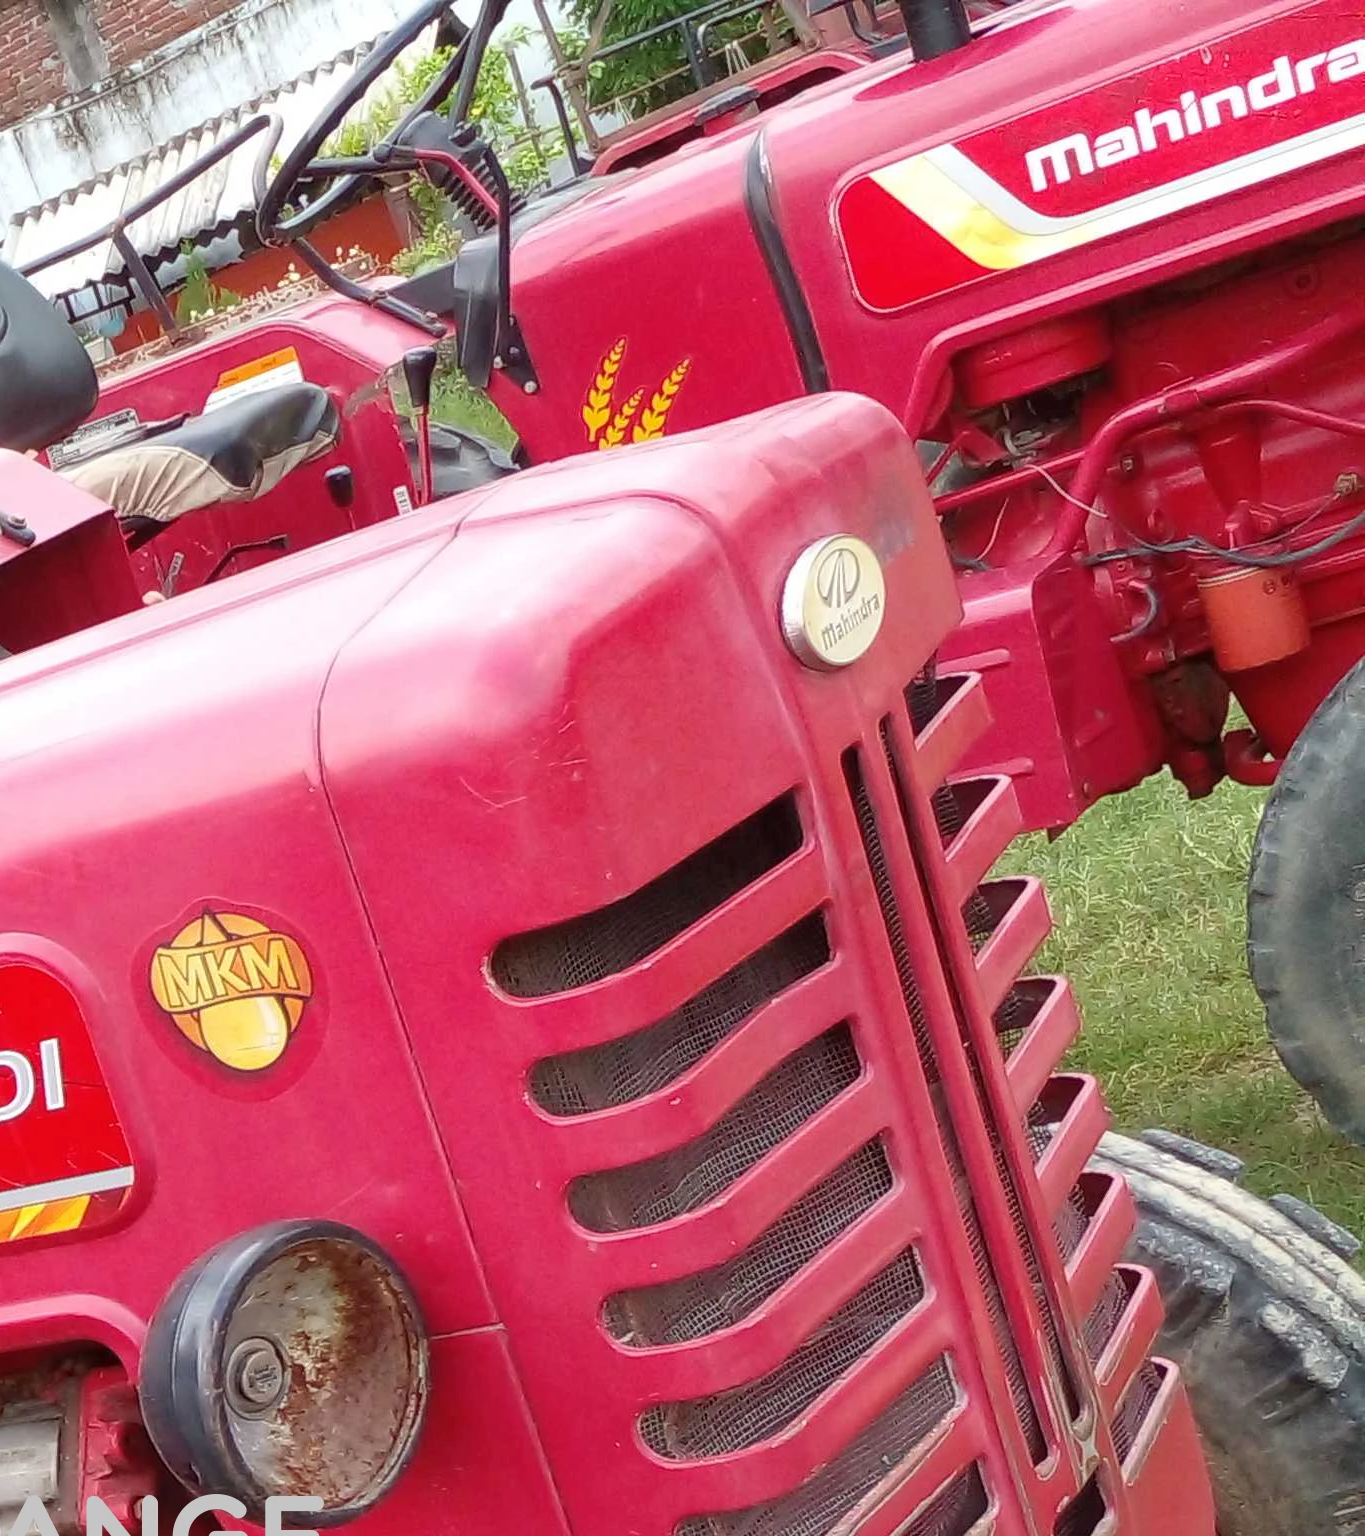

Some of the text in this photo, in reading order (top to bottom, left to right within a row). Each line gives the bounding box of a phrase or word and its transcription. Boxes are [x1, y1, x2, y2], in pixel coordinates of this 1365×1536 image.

[1024, 46, 1365, 193] Mahindra
[820, 593, 881, 651] Mahindra
[157, 937, 300, 1008] MKM
